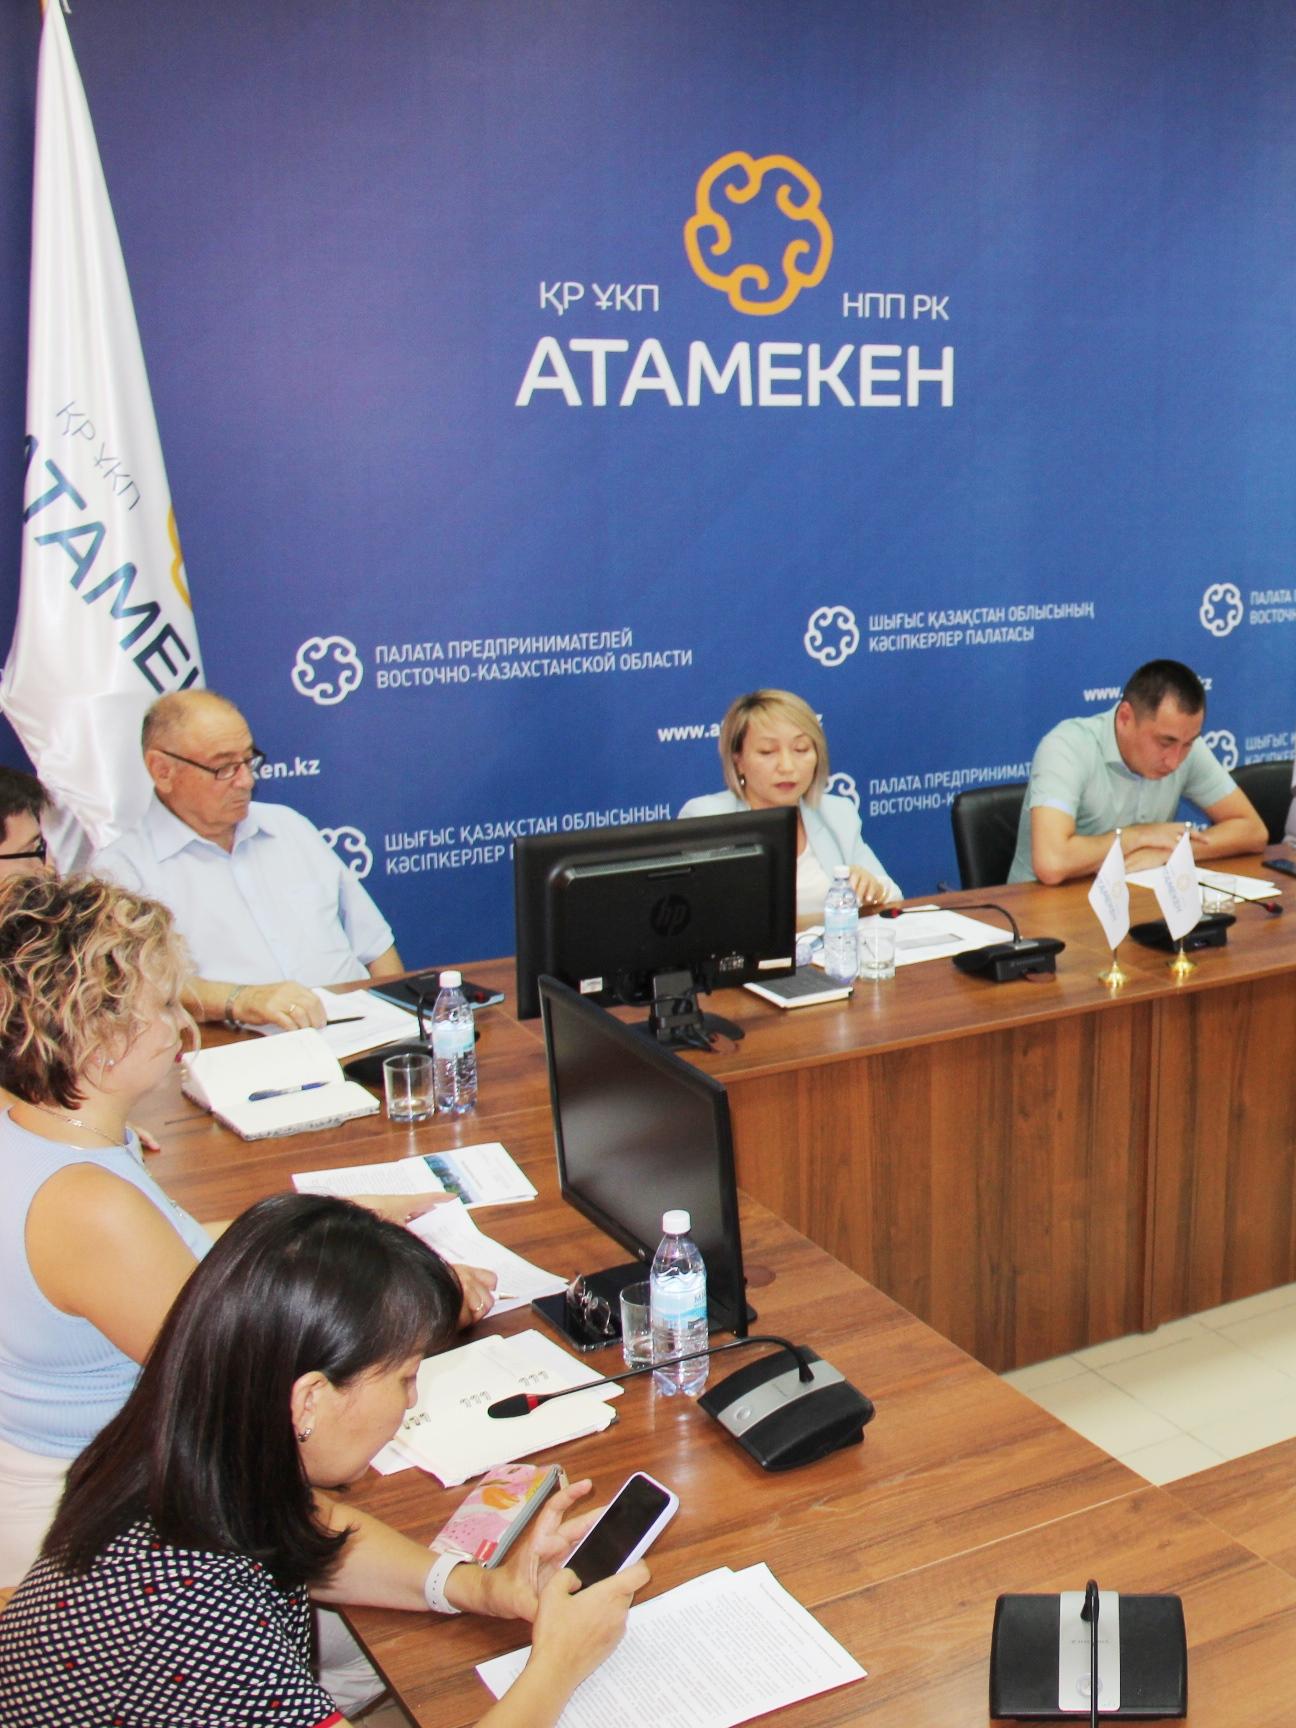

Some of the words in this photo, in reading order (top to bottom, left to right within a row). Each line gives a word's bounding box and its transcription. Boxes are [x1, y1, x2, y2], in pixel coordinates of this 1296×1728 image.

[592, 283, 660, 312] ҰКП
[842, 292, 906, 319] НПП
[912, 294, 950, 320] РК
[515, 336, 955, 407] АТАМЕКЕН
[1250, 589, 1292, 605] ПАЛАТА
[869, 611, 924, 631] ШЫҒЫС
[927, 606, 1005, 628] ҚАЗАҚСТАН
[1008, 602, 1095, 620] ОБЛЫСЫНЫҢ
[375, 643, 443, 664] ПАЛАТА
[447, 627, 633, 660] ПРЕДПРИНИМАТЕЛЕЙ
[869, 632, 963, 652] КӘСІПКЕРЛЕР
[966, 626, 1035, 645] ПАЛАТАСЫ
[377, 654, 615, 689] ВОСТОЧНО-КАЗАХСТАНСКОЙ
[619, 650, 693, 669] ОБЛАСТИ
[657, 719, 724, 743] www.a
[870, 775, 921, 795] ПАЛАТА
[870, 791, 961, 817] ВОСТОЧНО-К
[384, 826, 455, 852] ШЫҒЫС
[459, 815, 557, 845] ҚАЗАҚСТАН
[562, 804, 672, 832] ОБЛЫСЫНЫҢ
[385, 847, 505, 876] КӘСІПКЕРЛЕР
